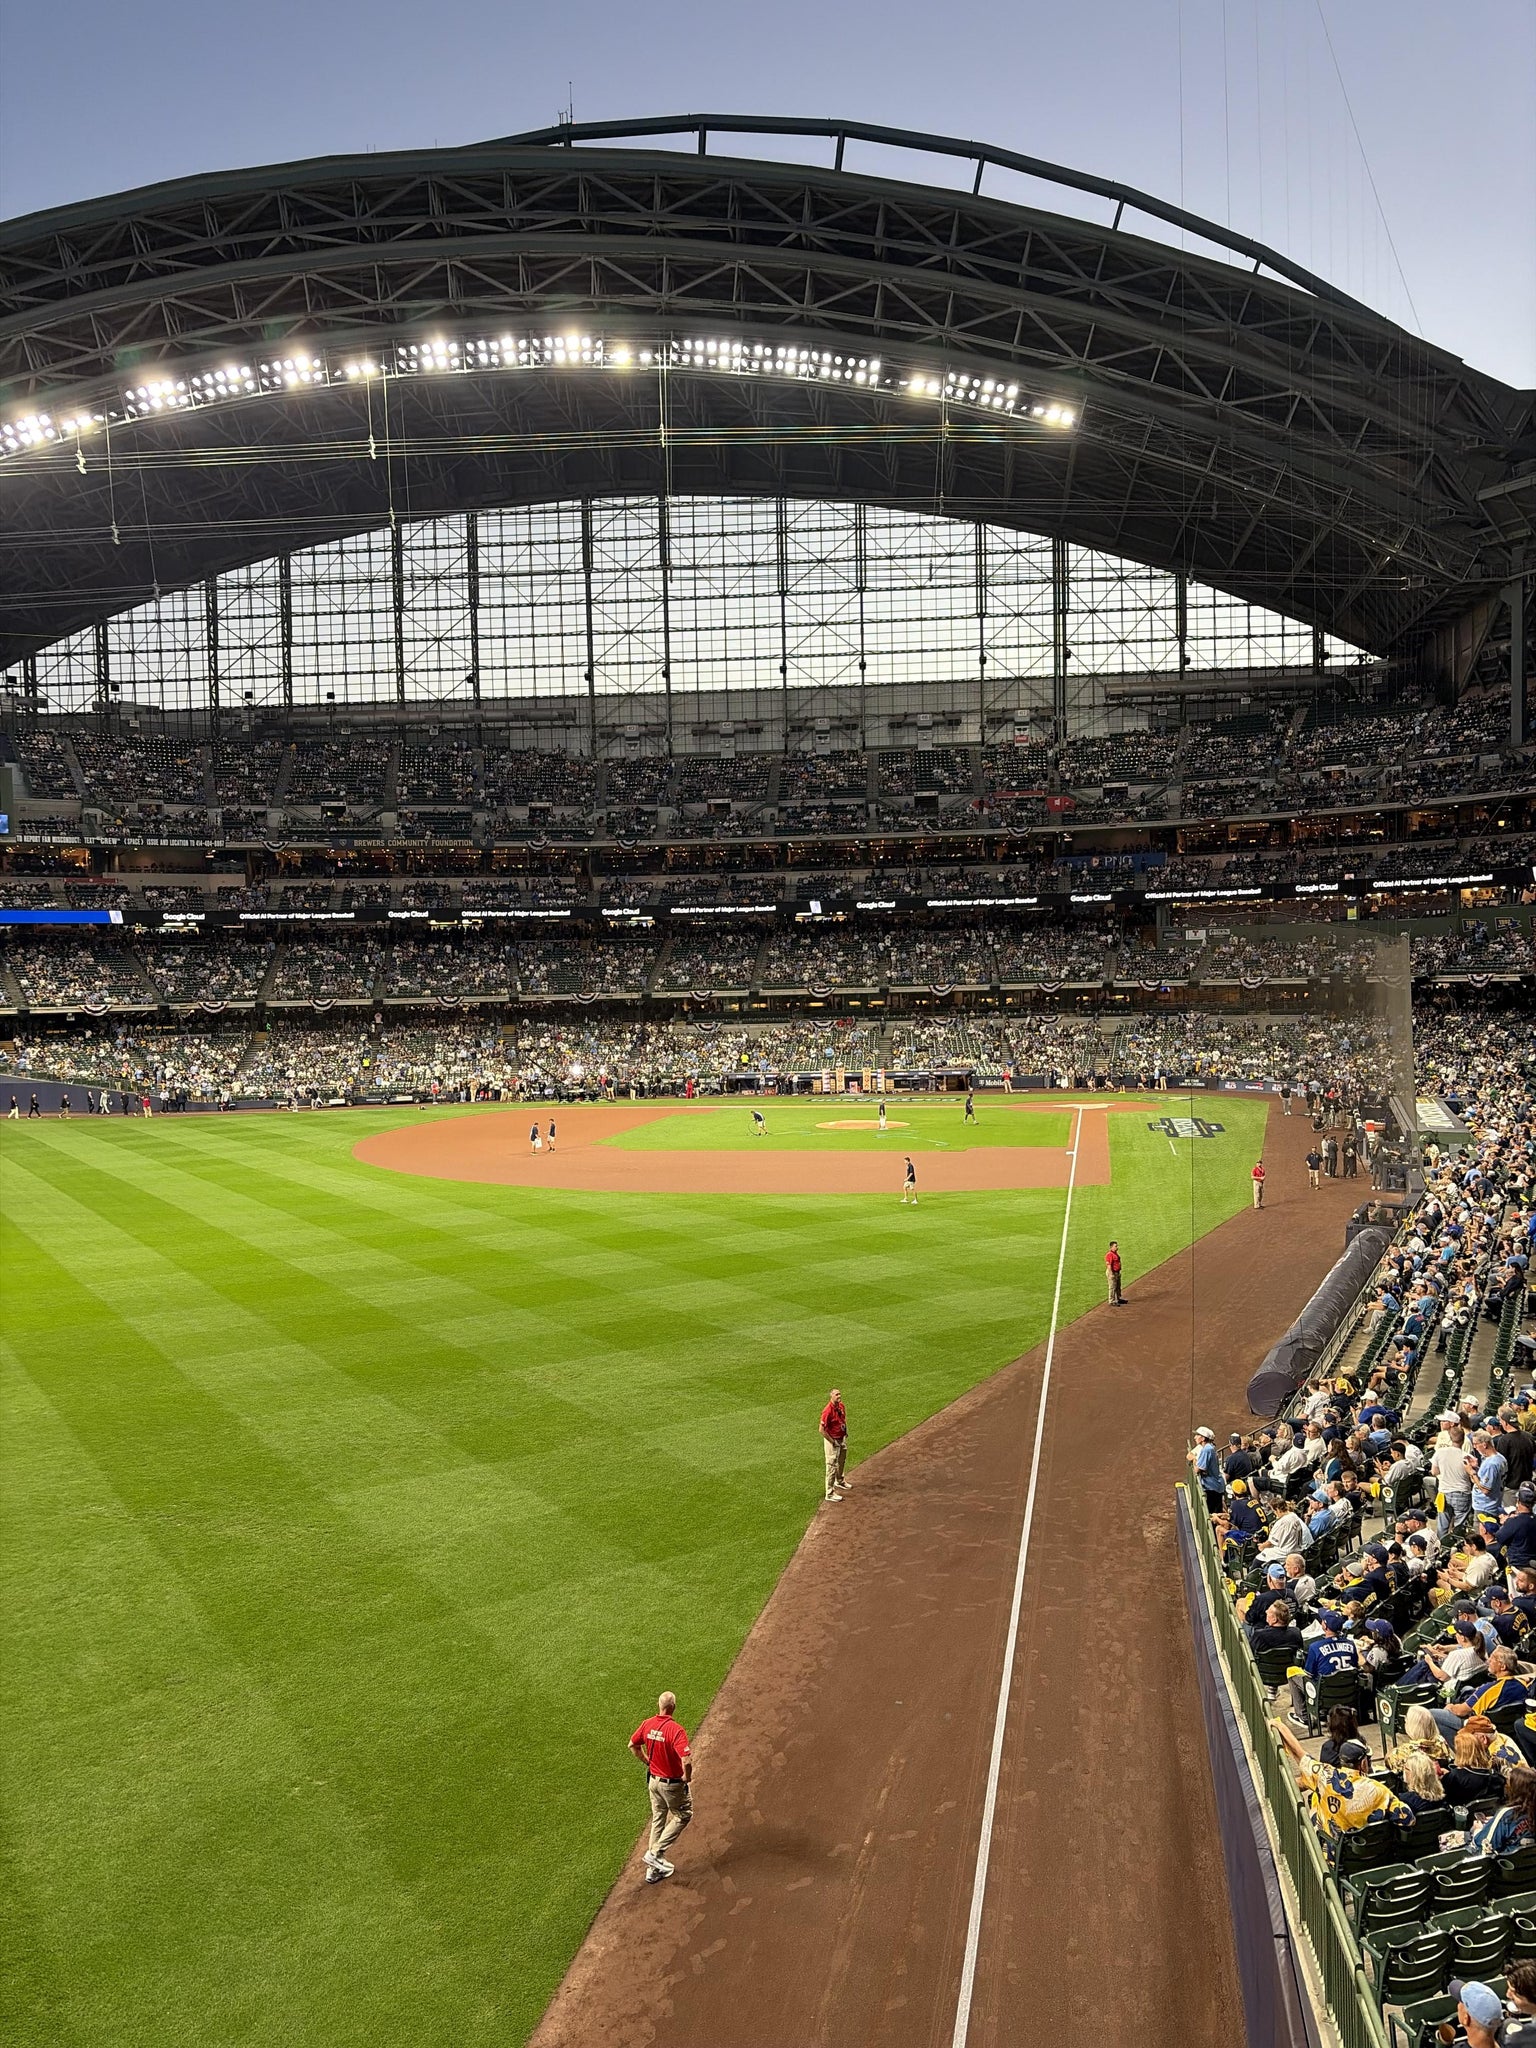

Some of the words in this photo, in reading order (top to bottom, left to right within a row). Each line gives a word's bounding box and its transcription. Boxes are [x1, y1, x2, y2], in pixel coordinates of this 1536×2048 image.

[84, 836, 95, 844] TEXT
[388, 839, 428, 847] COMMUNITY
[431, 839, 474, 847] FOUNDATION
[163, 913, 185, 921] Google
[1255, 1507, 1266, 1523] 9
[1319, 1643, 1354, 1656] BELLINGER
[1329, 1656, 1353, 1670] 35
